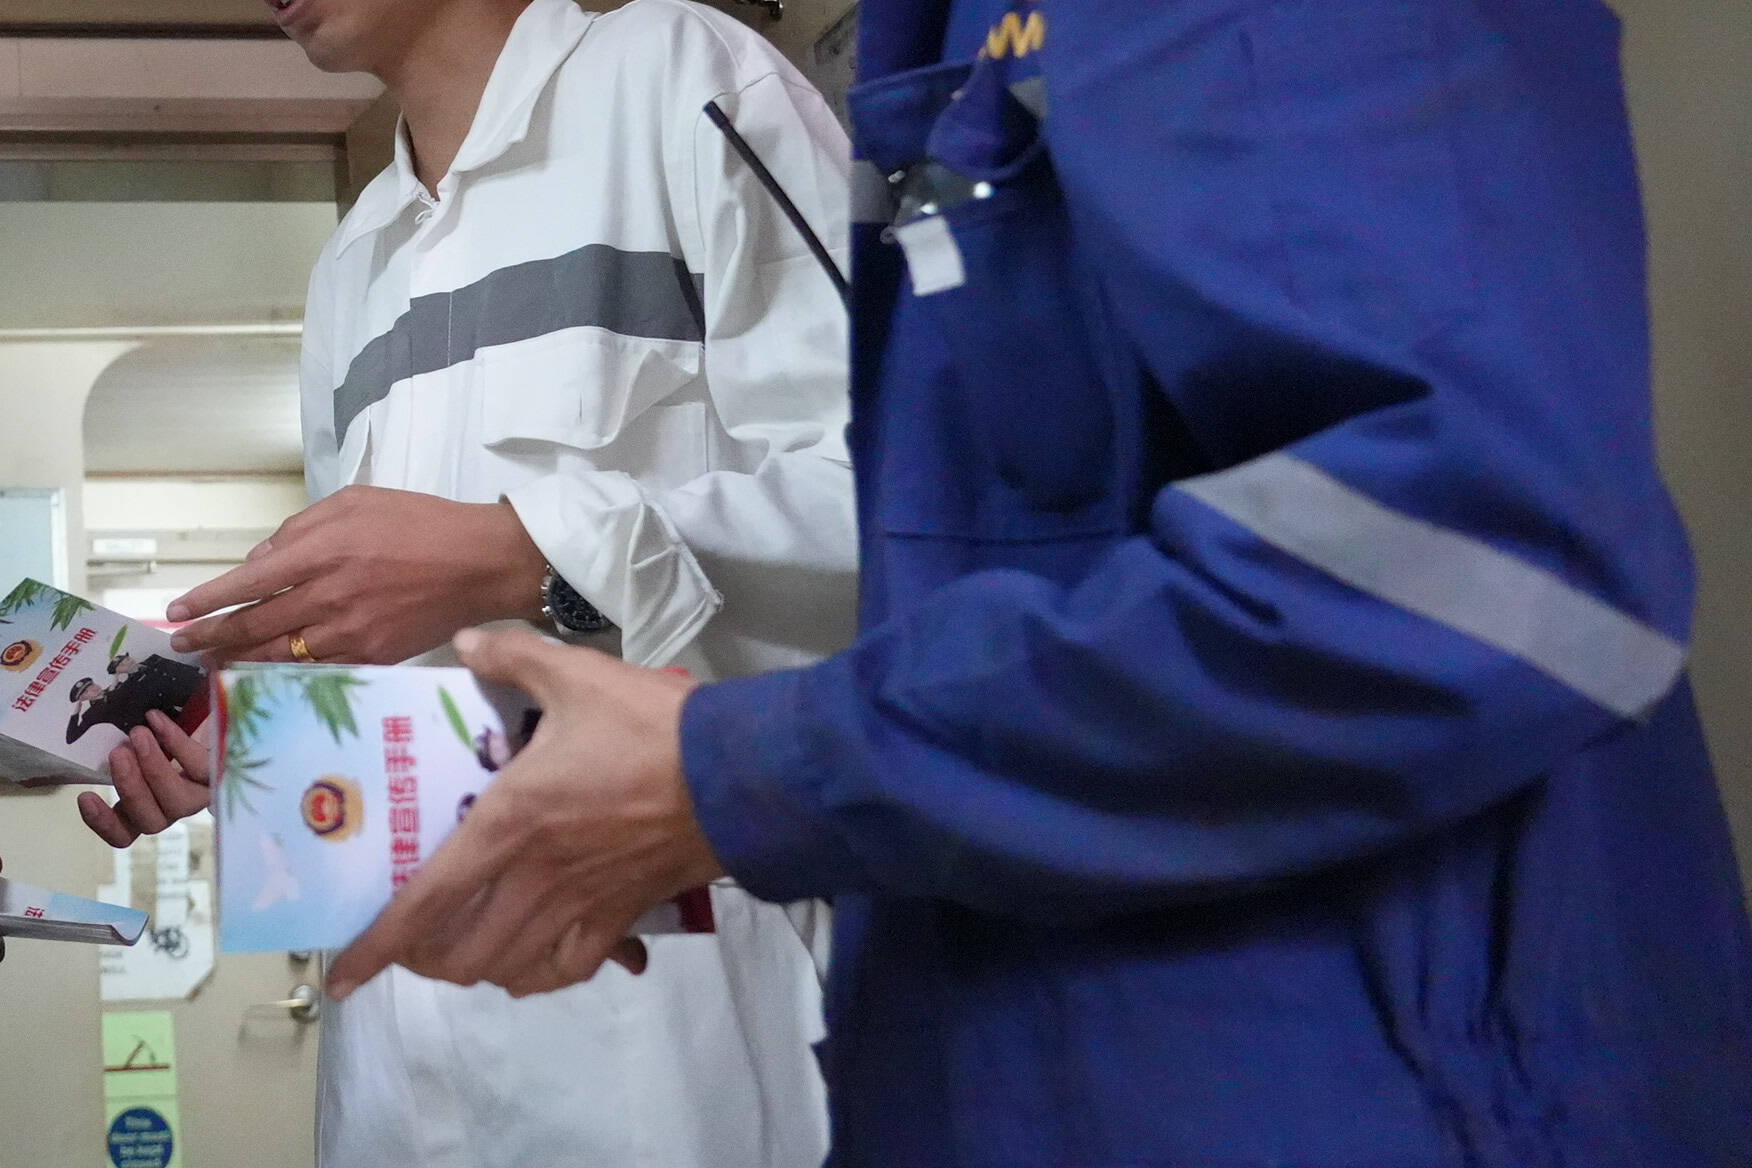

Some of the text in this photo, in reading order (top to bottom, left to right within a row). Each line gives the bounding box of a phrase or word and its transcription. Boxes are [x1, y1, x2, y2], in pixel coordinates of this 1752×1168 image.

[12, 627, 97, 712] 法律宣传手册
